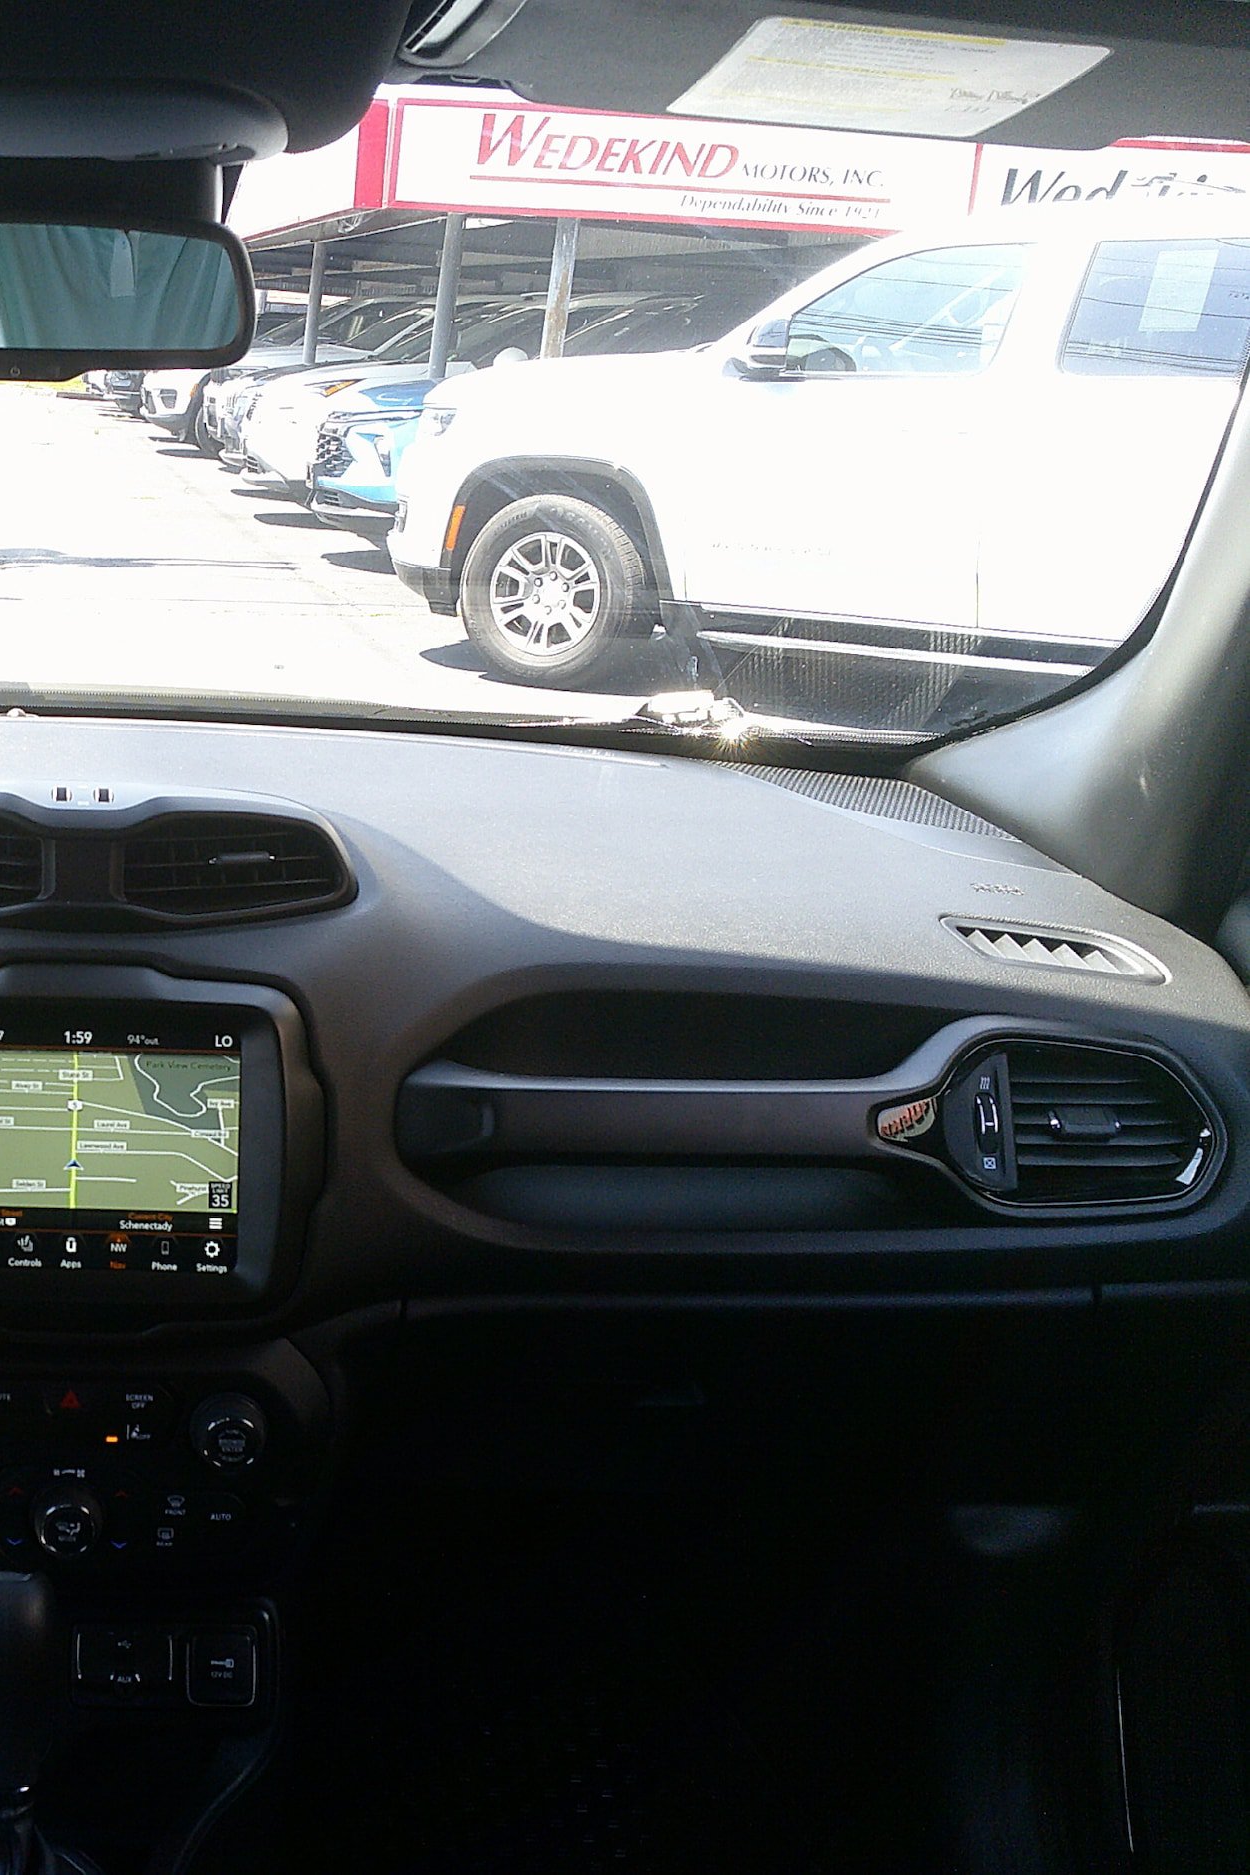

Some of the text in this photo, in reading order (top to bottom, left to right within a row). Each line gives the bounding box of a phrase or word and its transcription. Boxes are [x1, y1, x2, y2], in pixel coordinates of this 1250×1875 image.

[476, 112, 885, 190] WEDEKIND MOTORS, INC.
[680, 194, 791, 217] Dependability
[795, 203, 838, 218] Since
[63, 1030, 93, 1045] 1:59
[214, 1034, 234, 1048] LO
[167, 1060, 188, 1069] View
[211, 1194, 230, 1208] 35
[119, 1219, 173, 1232] Schenectady
[110, 1243, 128, 1253] NW
[7, 1257, 43, 1268] Controls
[59, 1258, 82, 1270] Apps
[151, 1260, 178, 1271] Phone
[195, 1262, 228, 1275] Settings
[209, 1512, 232, 1522] AUTO
